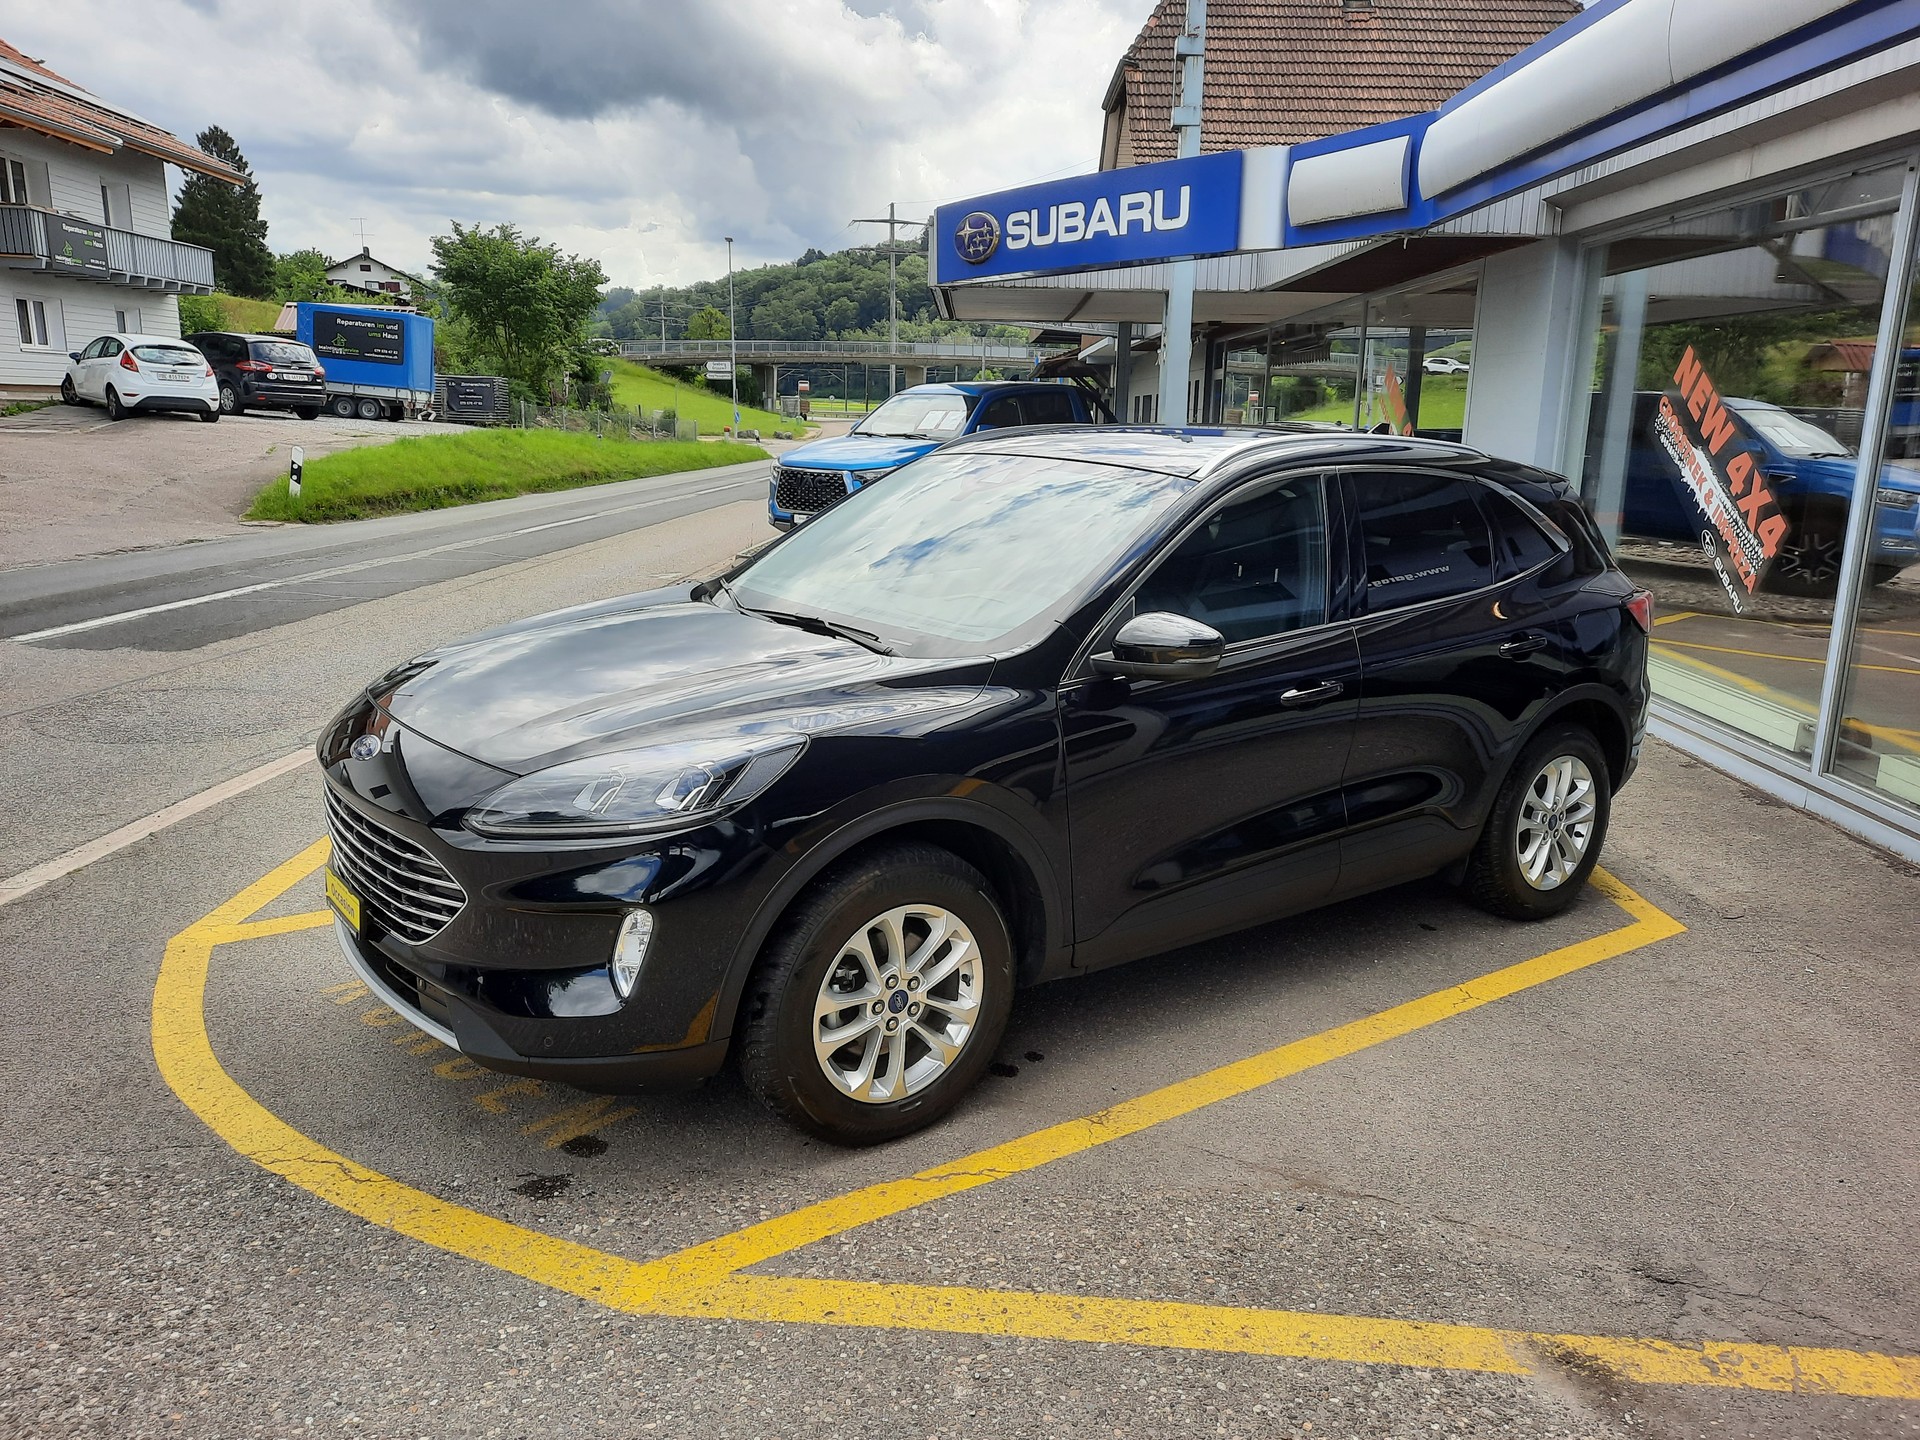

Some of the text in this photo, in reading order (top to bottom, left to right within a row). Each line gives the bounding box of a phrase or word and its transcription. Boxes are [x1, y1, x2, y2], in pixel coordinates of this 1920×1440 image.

[1006, 185, 1190, 250] SUBARU
[336, 318, 375, 327] Reparaturen
[382, 332, 398, 340] Haus
[792, 474, 830, 488] JAC
[1673, 344, 1788, 560] NEW 4X4
[1658, 395, 1707, 491] CROSSTREK
[1711, 503, 1757, 595] IMPREZA
[1713, 556, 1744, 615] SUBARU
